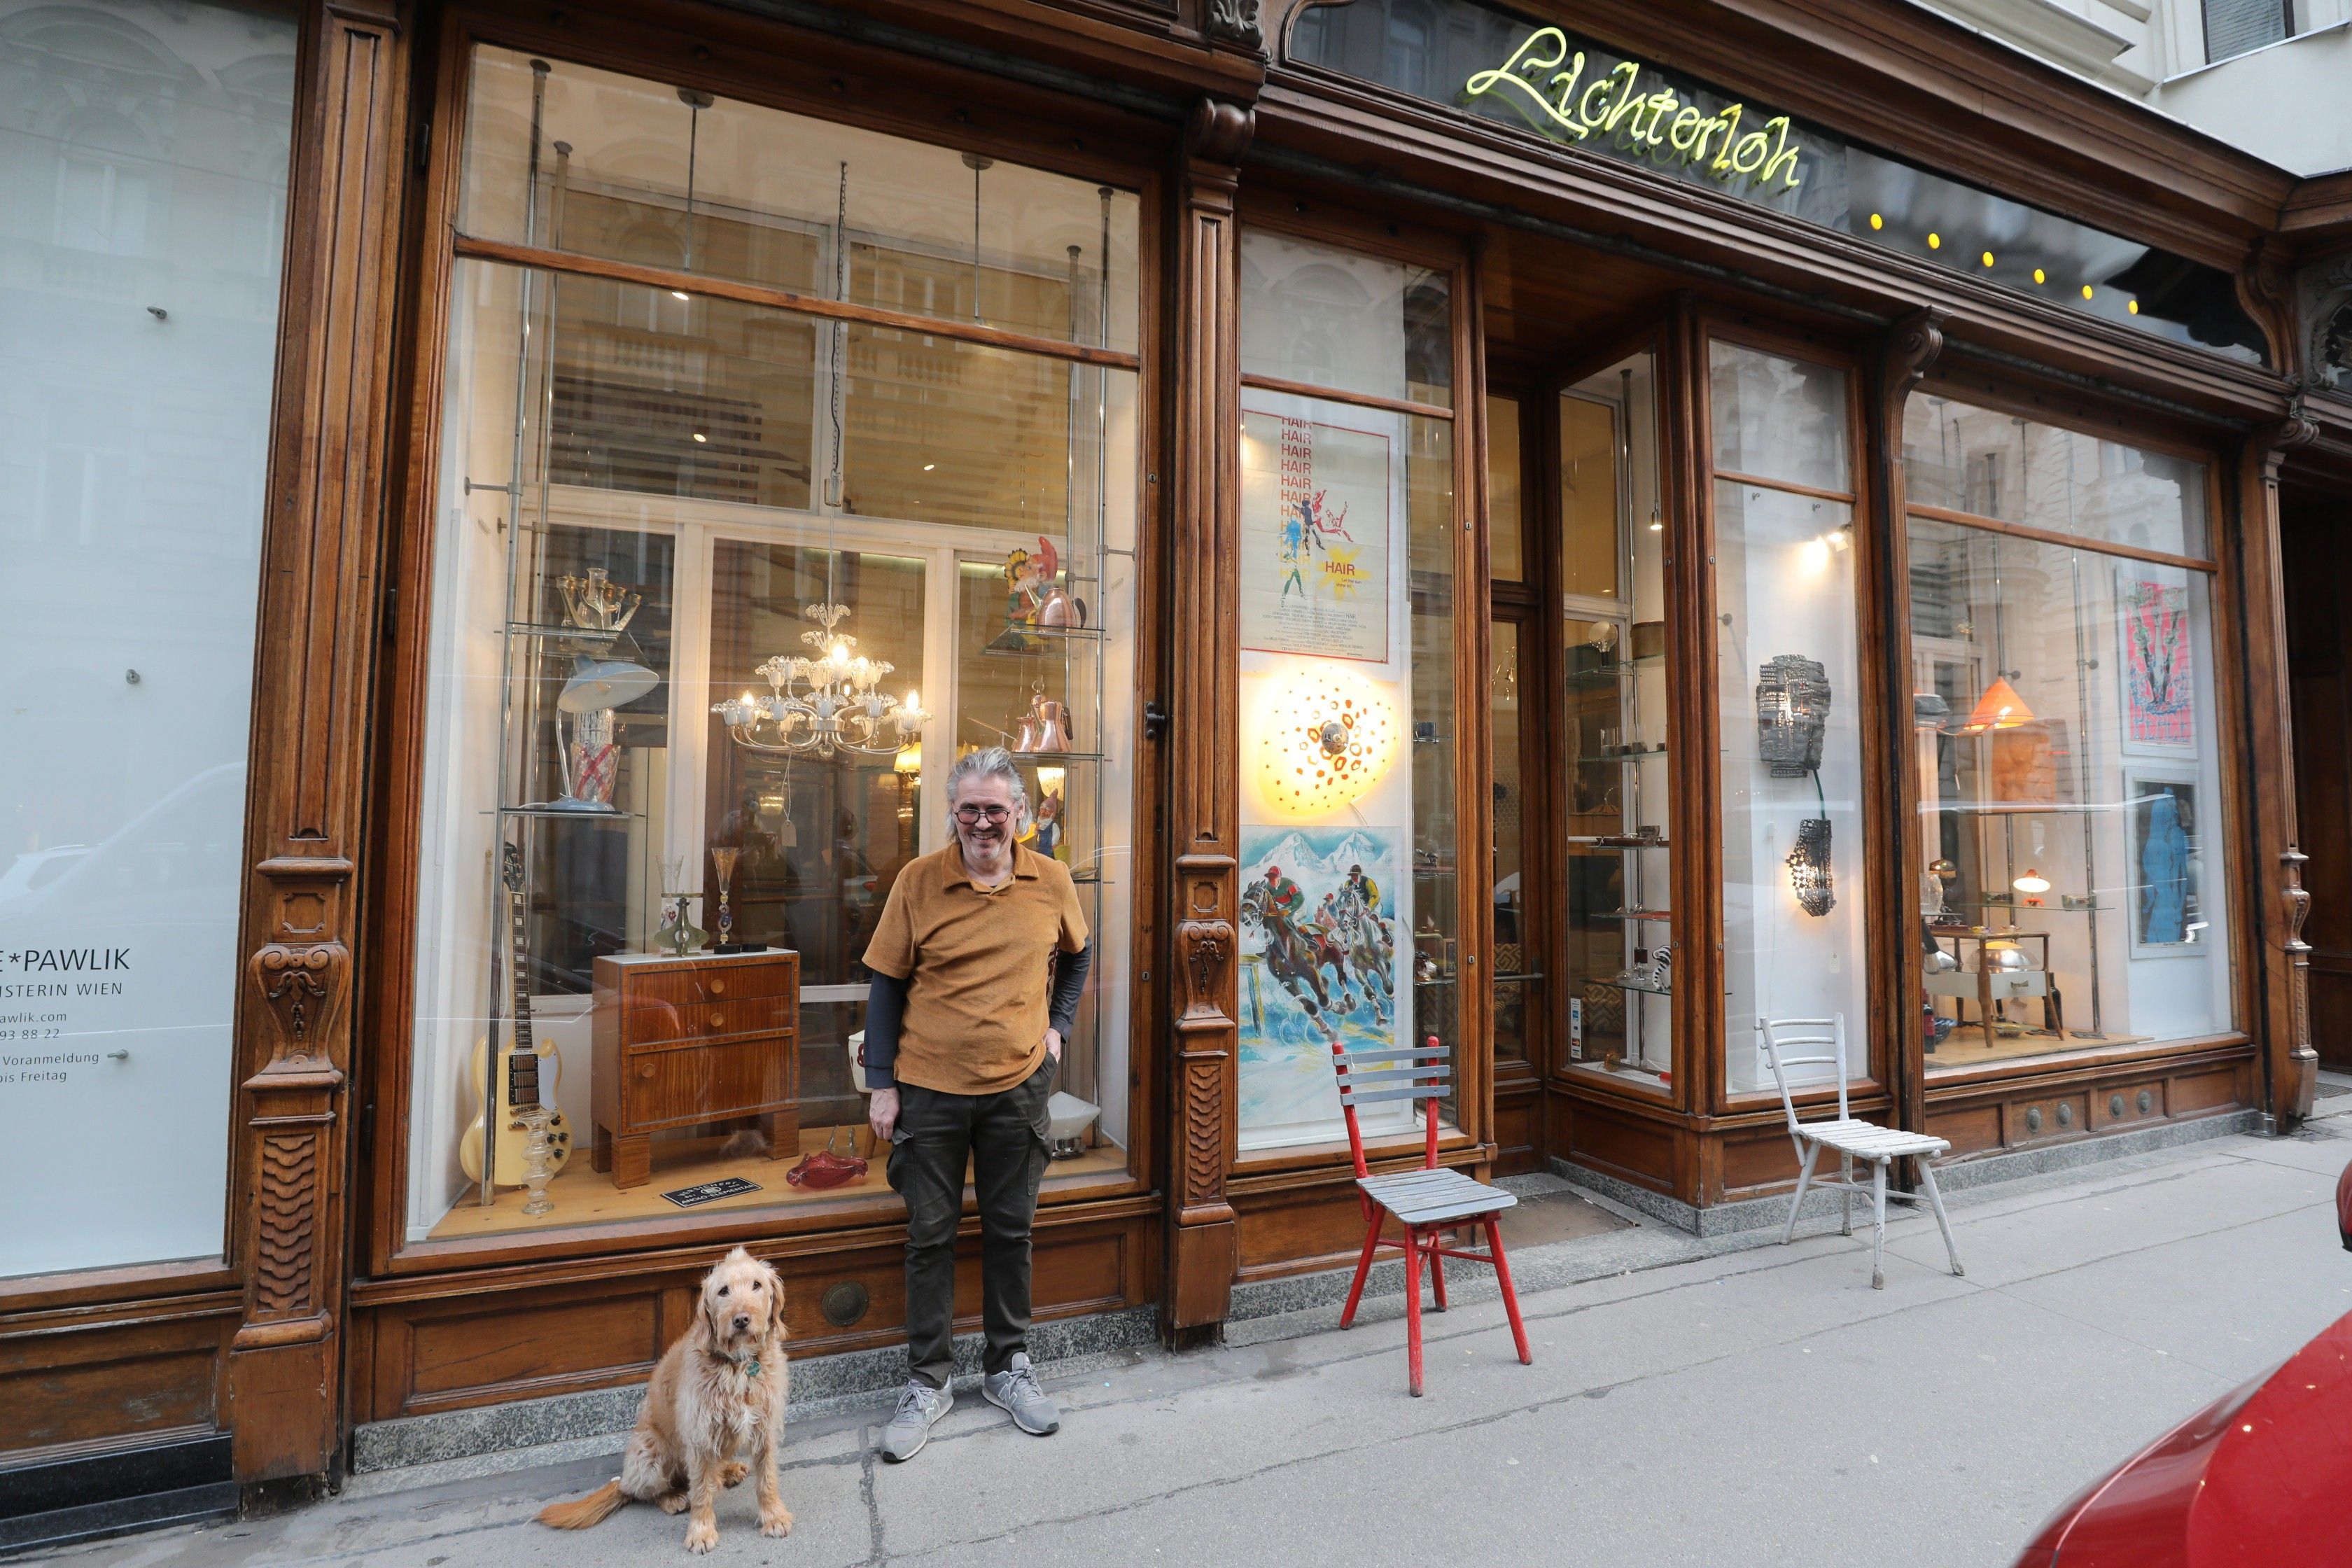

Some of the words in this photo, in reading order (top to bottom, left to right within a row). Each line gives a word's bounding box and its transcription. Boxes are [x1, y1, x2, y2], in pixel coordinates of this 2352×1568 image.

[1466, 27, 1800, 187] Lichterloh
[1282, 428, 1312, 444] HAIR
[1281, 444, 1312, 459] HAIR
[1281, 459, 1312, 475] HAIR
[1281, 475, 1311, 490] HAIR
[1325, 560, 1355, 576] HAIR
[77, 983, 122, 995] WIEN
[0, 1012, 67, 1023] awlik.com
[0, 1030, 15, 1040] 93
[22, 1030, 38, 1039] 88
[44, 1029, 59, 1039] 22
[3, 1053, 99, 1065] Voranmeldung
[21, 1070, 67, 1083] Freitag
